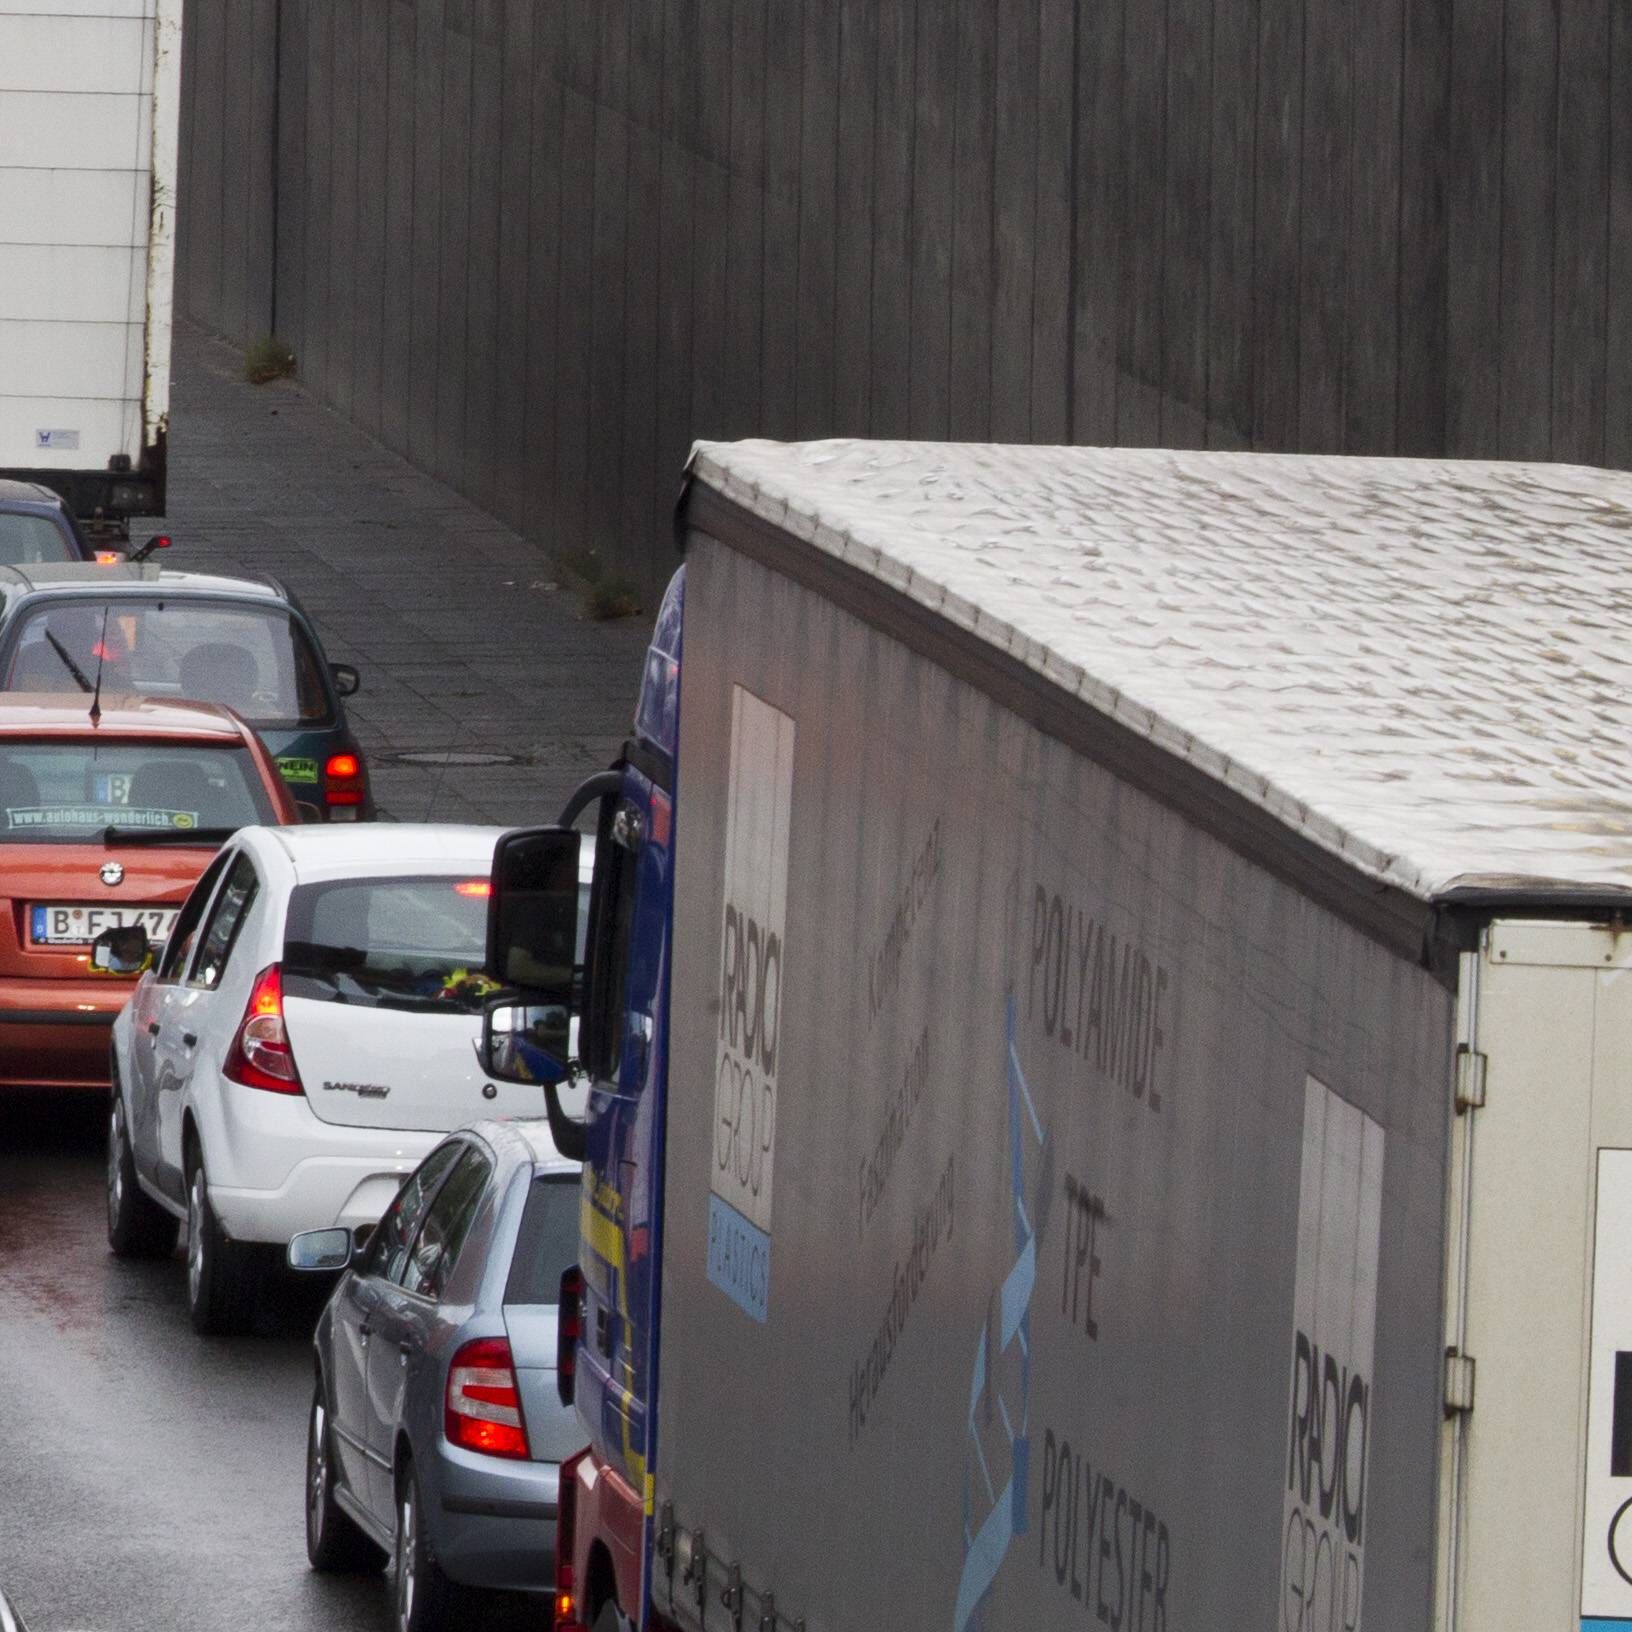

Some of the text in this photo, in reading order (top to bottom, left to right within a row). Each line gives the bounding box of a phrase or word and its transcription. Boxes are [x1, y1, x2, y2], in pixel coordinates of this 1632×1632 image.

[53, 910, 70, 935] B
[1029, 882, 1169, 1114] POLYAMIDE
[849, 1151, 955, 1447] Herausforderung
[1063, 1171, 1104, 1342] TPE
